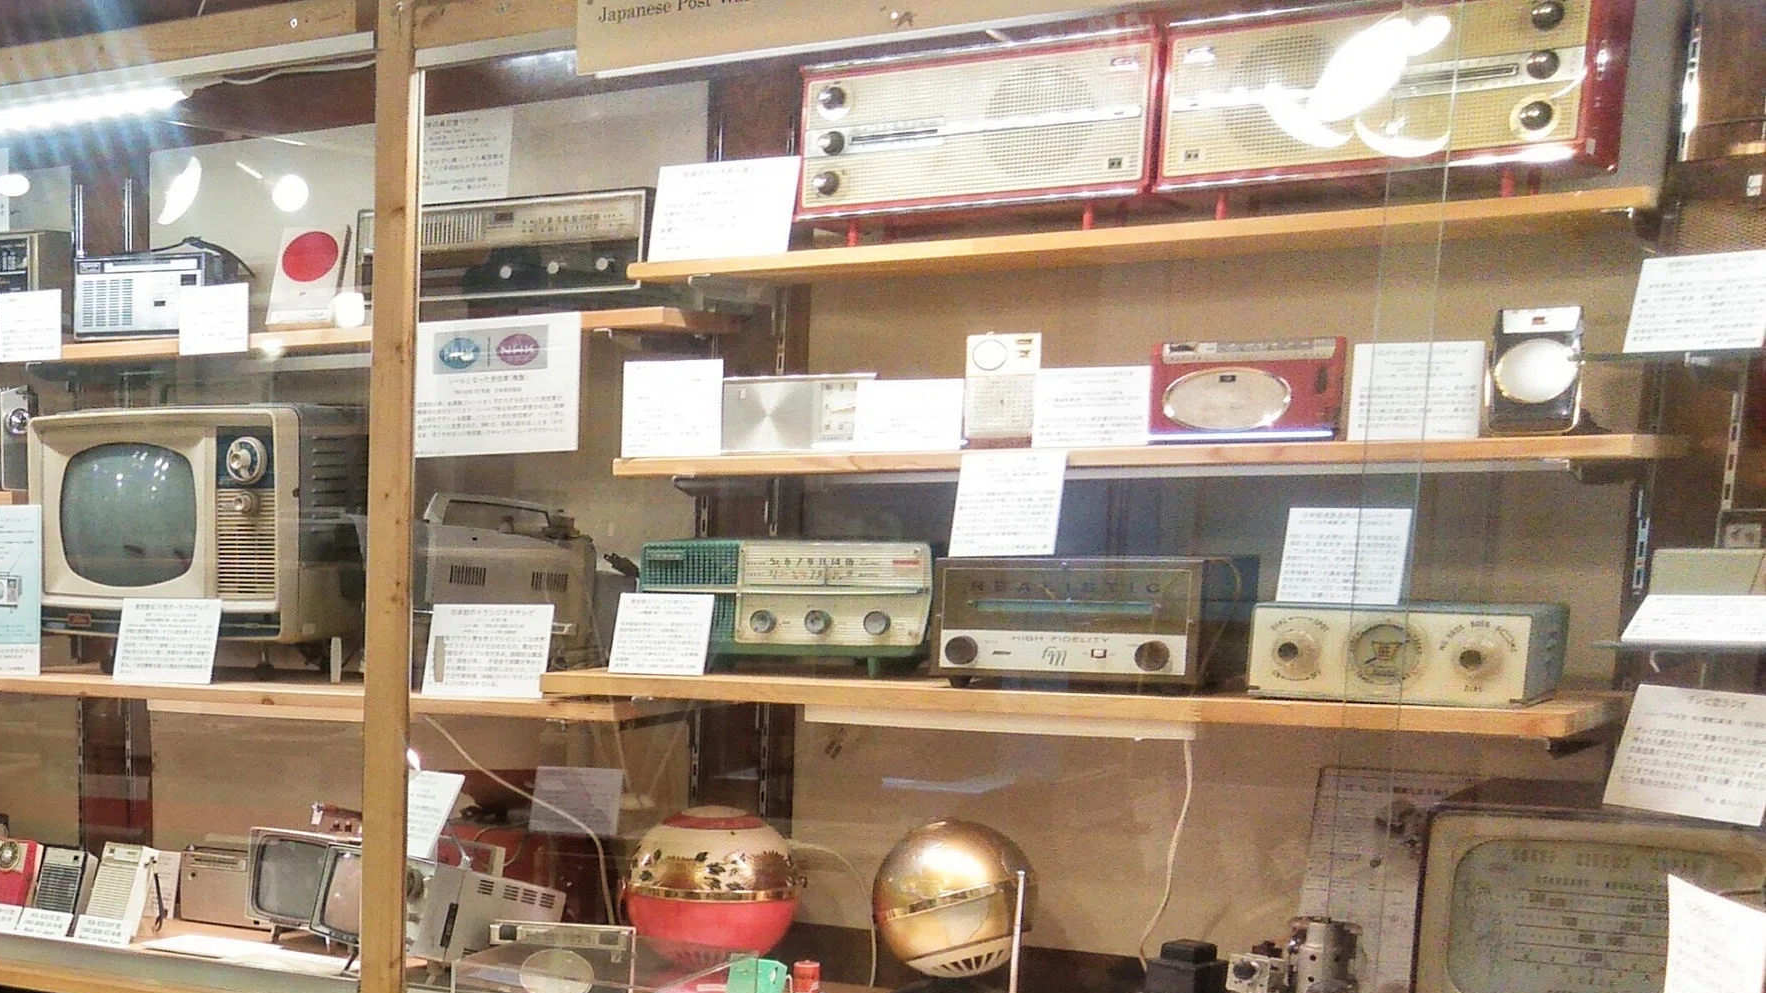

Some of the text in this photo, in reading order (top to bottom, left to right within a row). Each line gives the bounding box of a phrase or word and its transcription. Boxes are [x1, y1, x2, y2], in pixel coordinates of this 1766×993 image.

[598, 3, 671, 24] Japanese
[1011, 634, 1111, 645] HIGH FIDELITY
